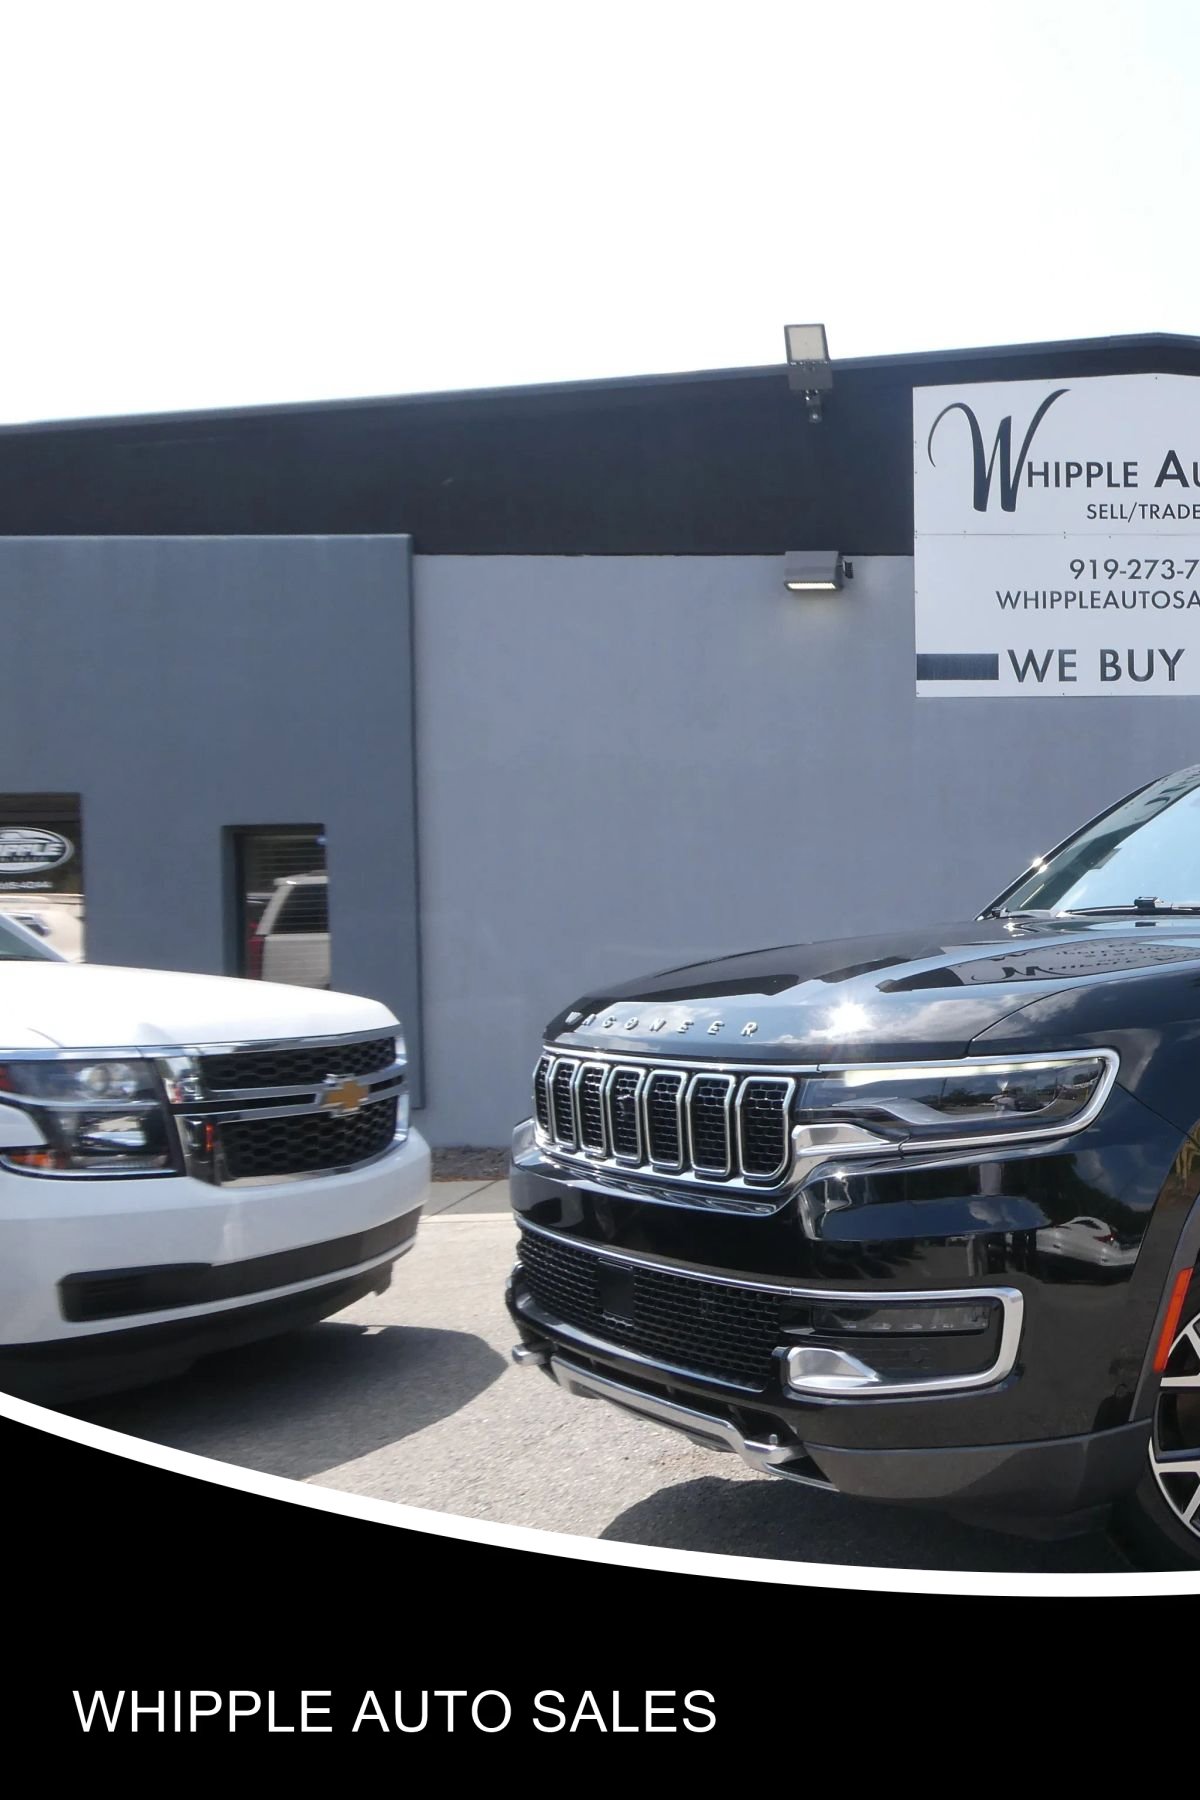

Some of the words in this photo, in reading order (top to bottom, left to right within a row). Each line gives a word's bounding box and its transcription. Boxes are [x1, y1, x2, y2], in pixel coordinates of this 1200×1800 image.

[927, 388, 1139, 513] WHIPPLE
[1007, 648, 1078, 683] WE
[1099, 648, 1186, 682] BUY
[565, 1011, 759, 1037] WAGONEER
